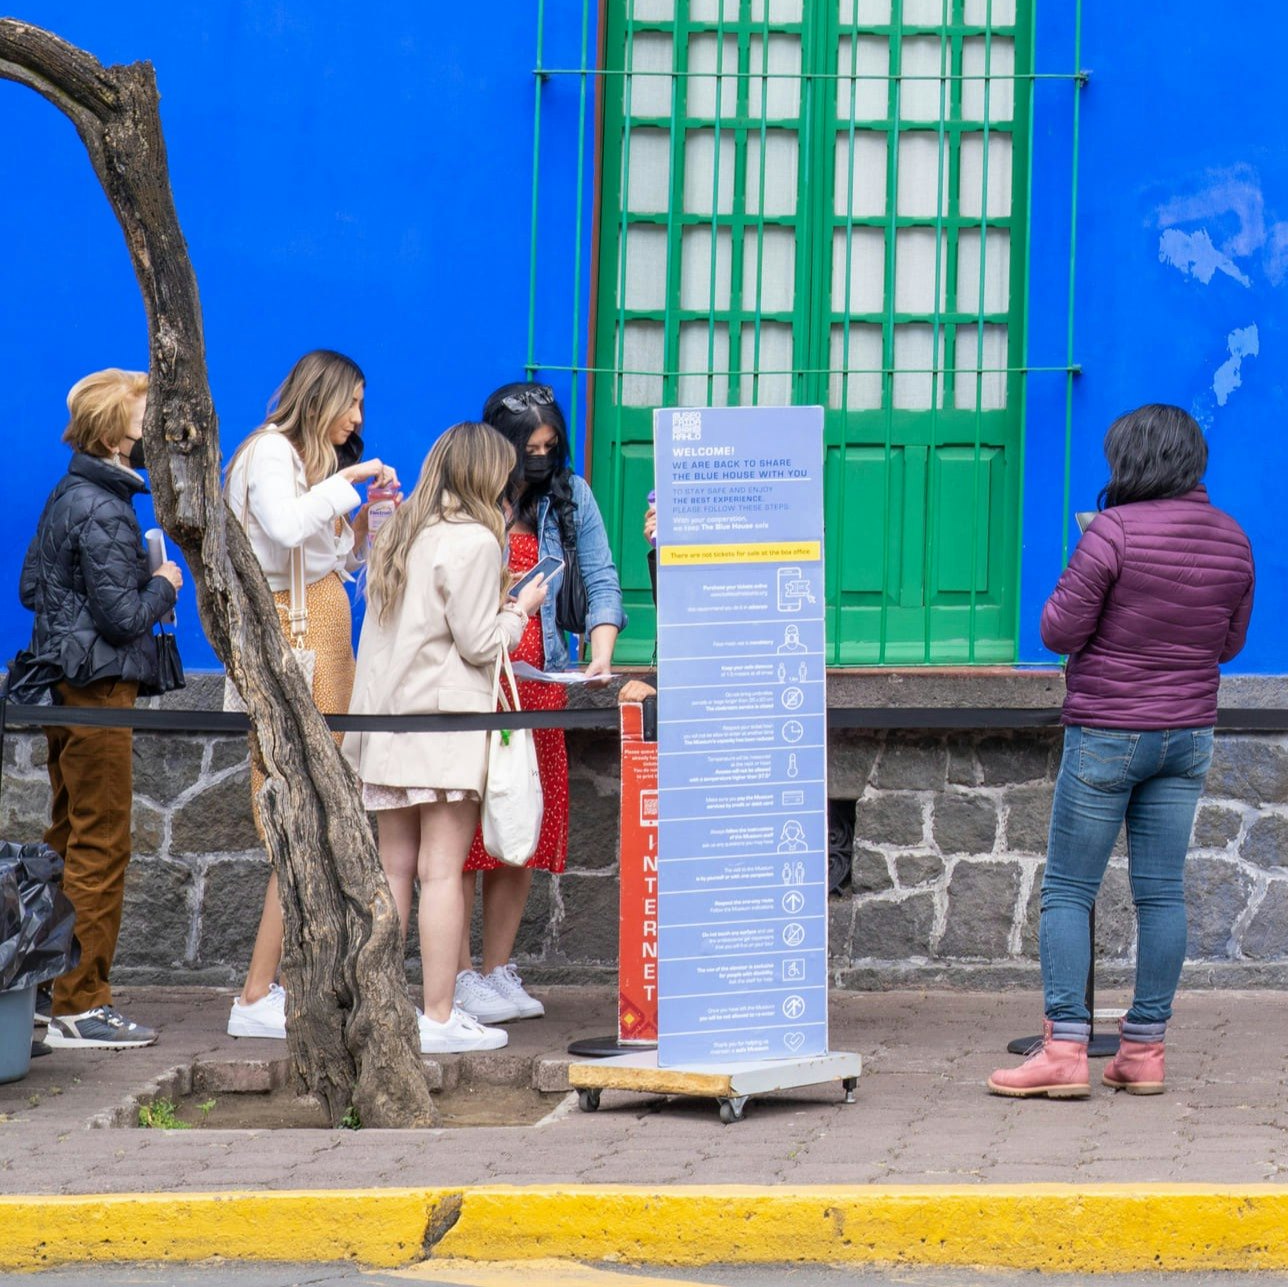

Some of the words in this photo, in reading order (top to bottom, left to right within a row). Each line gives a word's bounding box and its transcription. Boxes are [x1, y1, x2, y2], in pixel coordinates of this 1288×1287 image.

[672, 447, 735, 457] WELCOME!
[672, 461, 688, 469] WE
[690, 460, 712, 469] ARE
[713, 460, 740, 469] BACK
[743, 459, 756, 468] TO
[759, 459, 792, 468] SHARE
[672, 473, 692, 481] THE
[693, 472, 721, 480] BLUE
[722, 471, 757, 480] HOUSE
[758, 470, 785, 479] WITH
[786, 470, 808, 478] YOU
[706, 487, 727, 495] SAFE
[728, 486, 746, 494] AND
[703, 505, 737, 513] FOLLOW
[738, 504, 762, 512] THESE
[643, 834, 658, 1001] INTERNET
